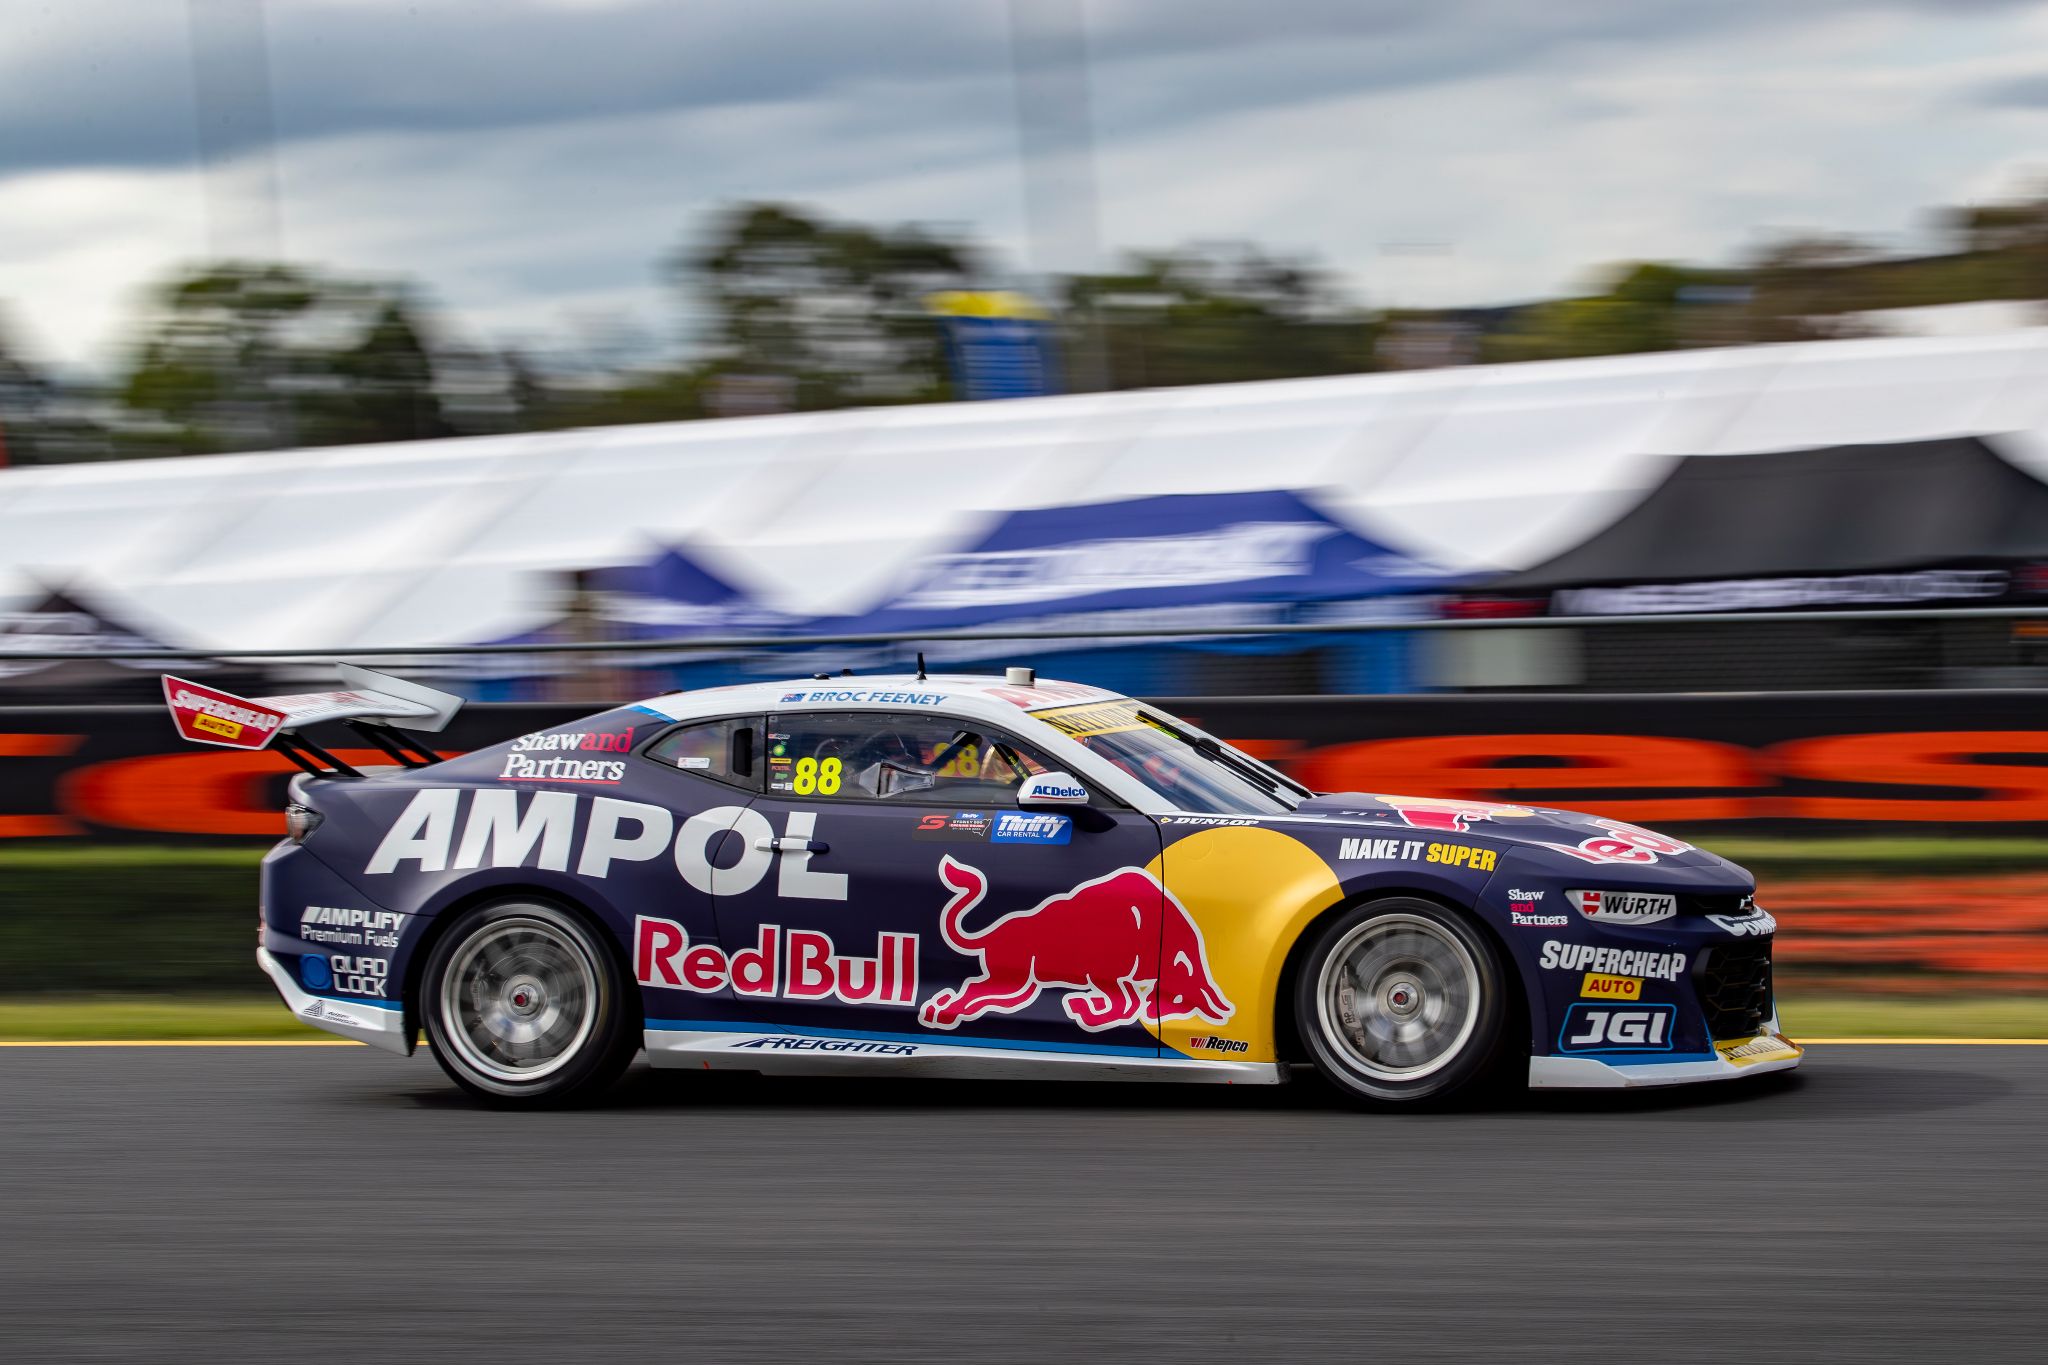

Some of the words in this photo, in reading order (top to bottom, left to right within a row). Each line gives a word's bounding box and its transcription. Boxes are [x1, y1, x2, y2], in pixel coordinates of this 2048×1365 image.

[808, 691, 867, 702] BROC
[867, 692, 948, 705] FEENEY
[173, 689, 281, 732] SUPERCHEAP
[200, 717, 236, 735] AUTO
[500, 753, 626, 781] Partners
[793, 757, 842, 795] 88
[1032, 785, 1086, 797] ACDelco
[998, 815, 1068, 838] Thrifty
[1173, 817, 1259, 826] DUNLOP
[364, 788, 848, 901] AMPOL
[1339, 838, 1399, 860] MAKE
[1401, 841, 1425, 860] IT
[1426, 843, 1497, 872] SUPER
[1508, 889, 1545, 901] Shaw
[1604, 896, 1672, 915] WÜRTH
[1510, 902, 1534, 913] and
[1512, 912, 1568, 925] Partners
[317, 907, 406, 931] AMPLIFY
[301, 925, 362, 944] Premium
[364, 930, 399, 948] Fuels
[331, 955, 389, 977] QUAD
[1540, 940, 1687, 981] SUPERCHEAP
[332, 973, 388, 998] LOCK
[1588, 979, 1635, 994] AUTO
[1571, 1012, 1667, 1044] JGI
[755, 1037, 920, 1056] FREIGHTER
[1205, 1036, 1249, 1053] Repco
